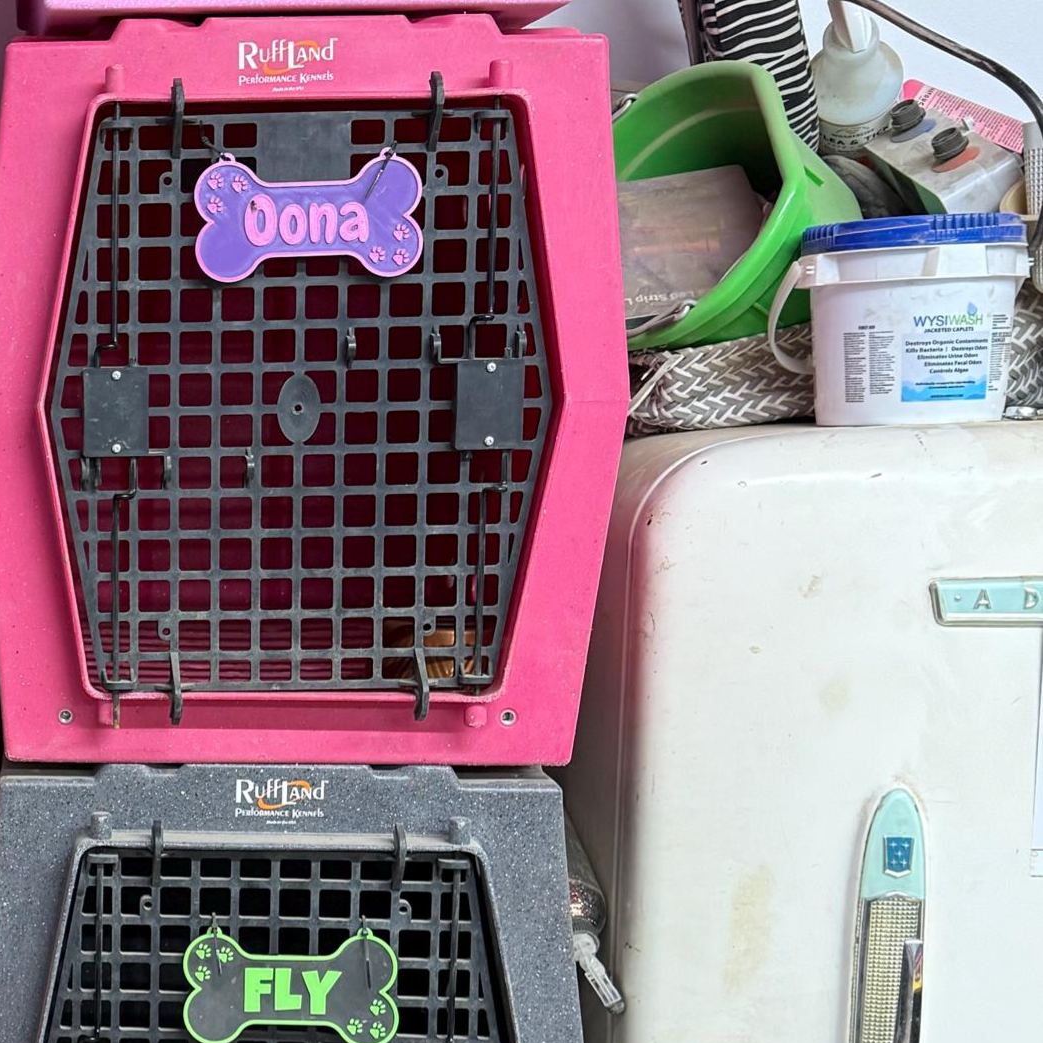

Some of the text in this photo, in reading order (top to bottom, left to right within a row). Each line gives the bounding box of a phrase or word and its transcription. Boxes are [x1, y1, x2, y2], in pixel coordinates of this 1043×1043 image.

[244, 194, 370, 247] Oona
[913, 314, 983, 328] WYSIWASH
[243, 967, 343, 1016] FLY
